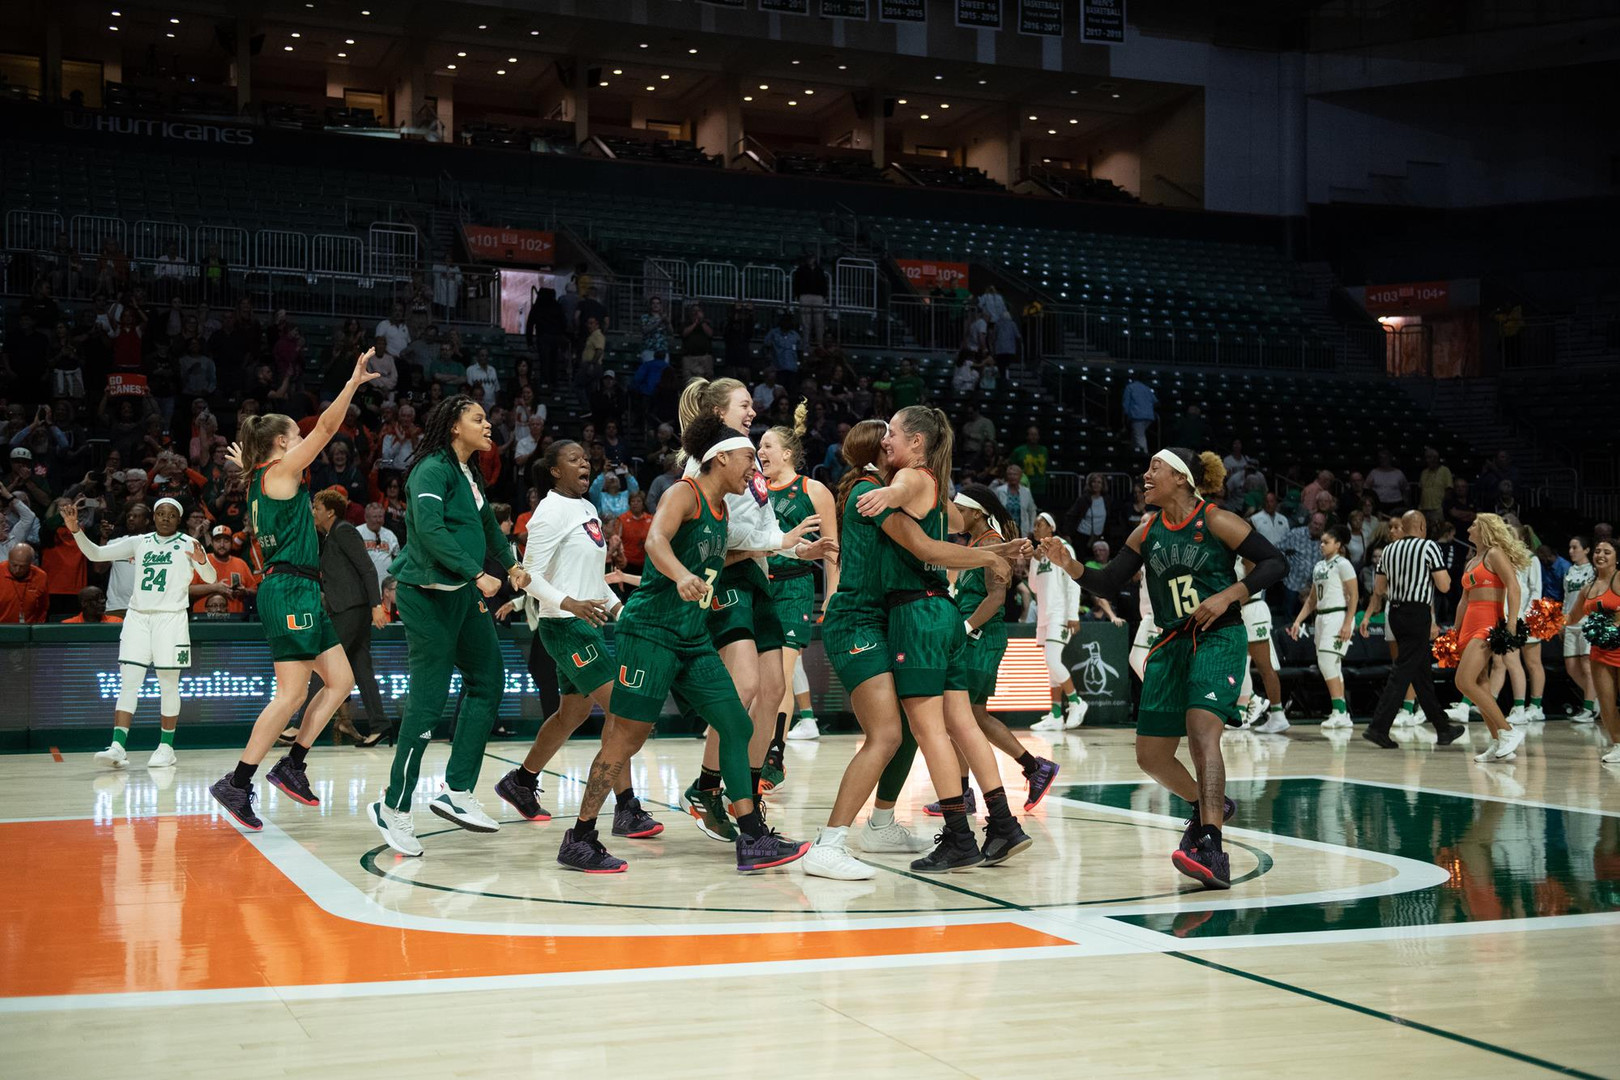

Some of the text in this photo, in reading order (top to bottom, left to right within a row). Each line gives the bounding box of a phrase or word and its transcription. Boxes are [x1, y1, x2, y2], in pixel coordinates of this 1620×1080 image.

[476, 234, 498, 249] 101
[520, 238, 543, 252] 102
[1376, 290, 1399, 303] 103
[1417, 286, 1439, 300] 104
[1149, 543, 1210, 579] MIAMI
[141, 567, 168, 592] 24
[1168, 574, 1201, 619] 13
